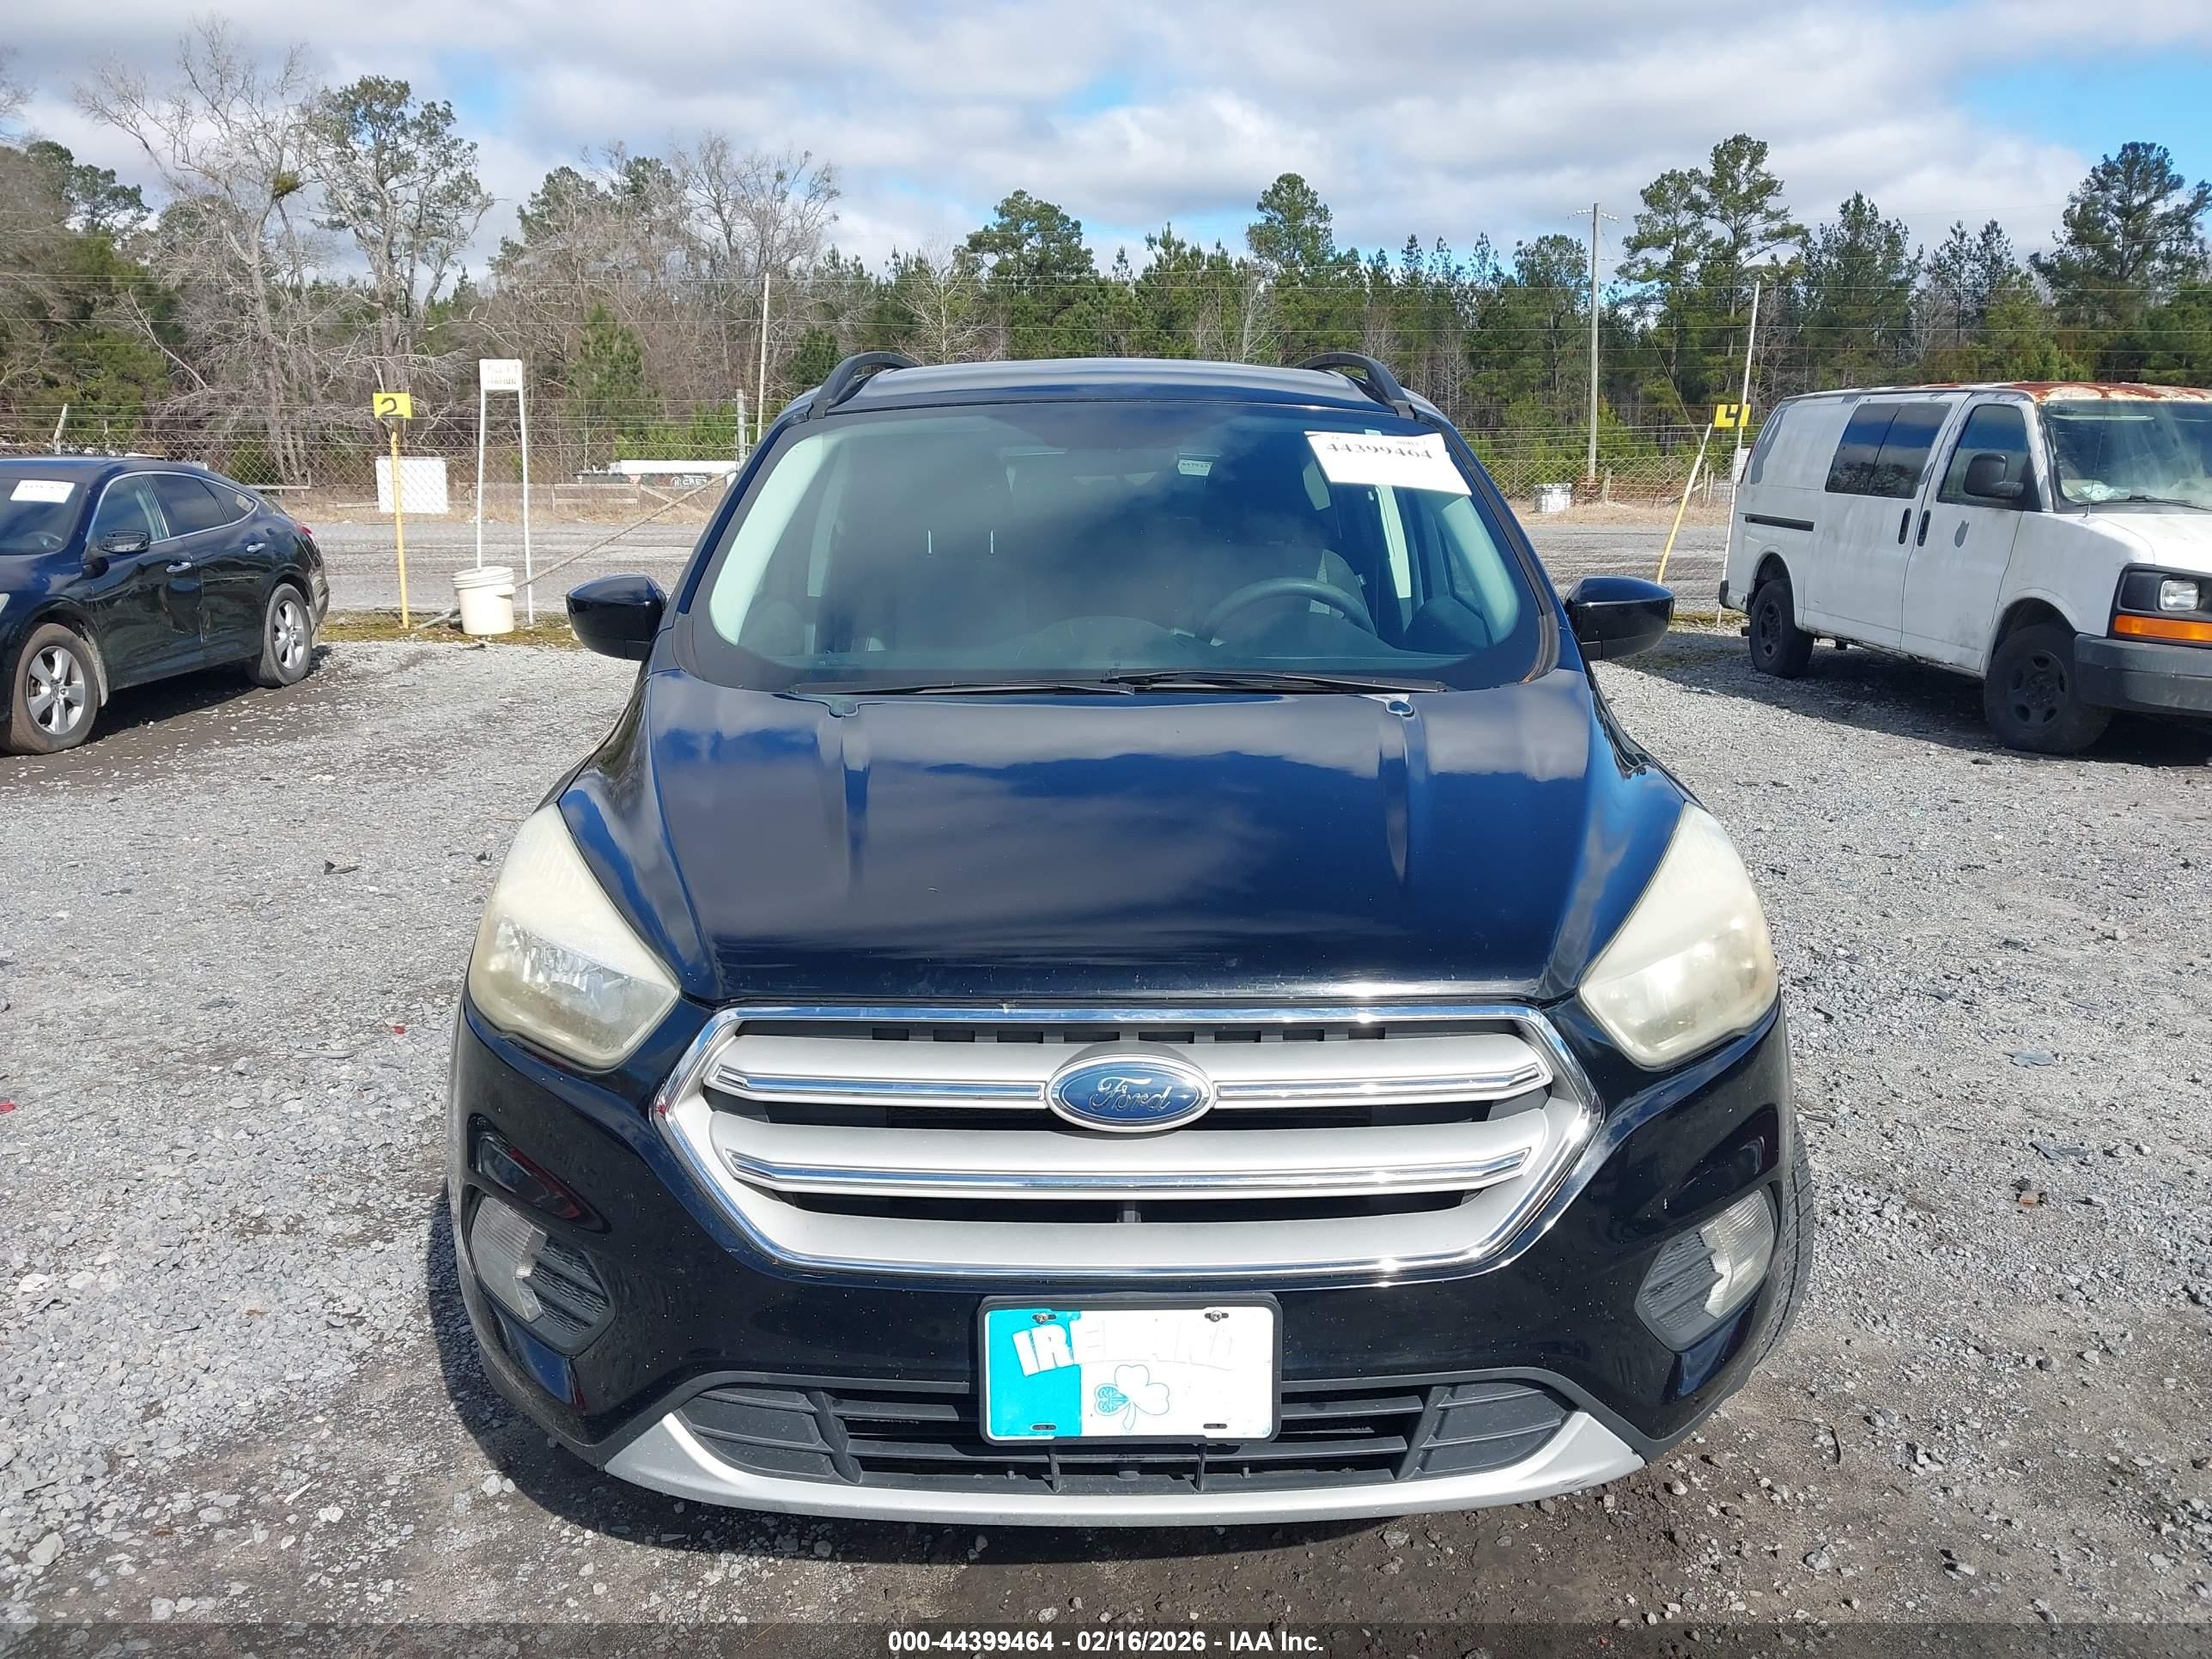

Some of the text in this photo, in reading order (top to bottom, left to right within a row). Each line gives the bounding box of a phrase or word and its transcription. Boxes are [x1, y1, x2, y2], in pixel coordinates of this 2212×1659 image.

[380, 398, 404, 417] 2
[1725, 405, 1743, 426] 4
[1326, 441, 1433, 460] 44399464
[1089, 1076, 1174, 1112] Ford
